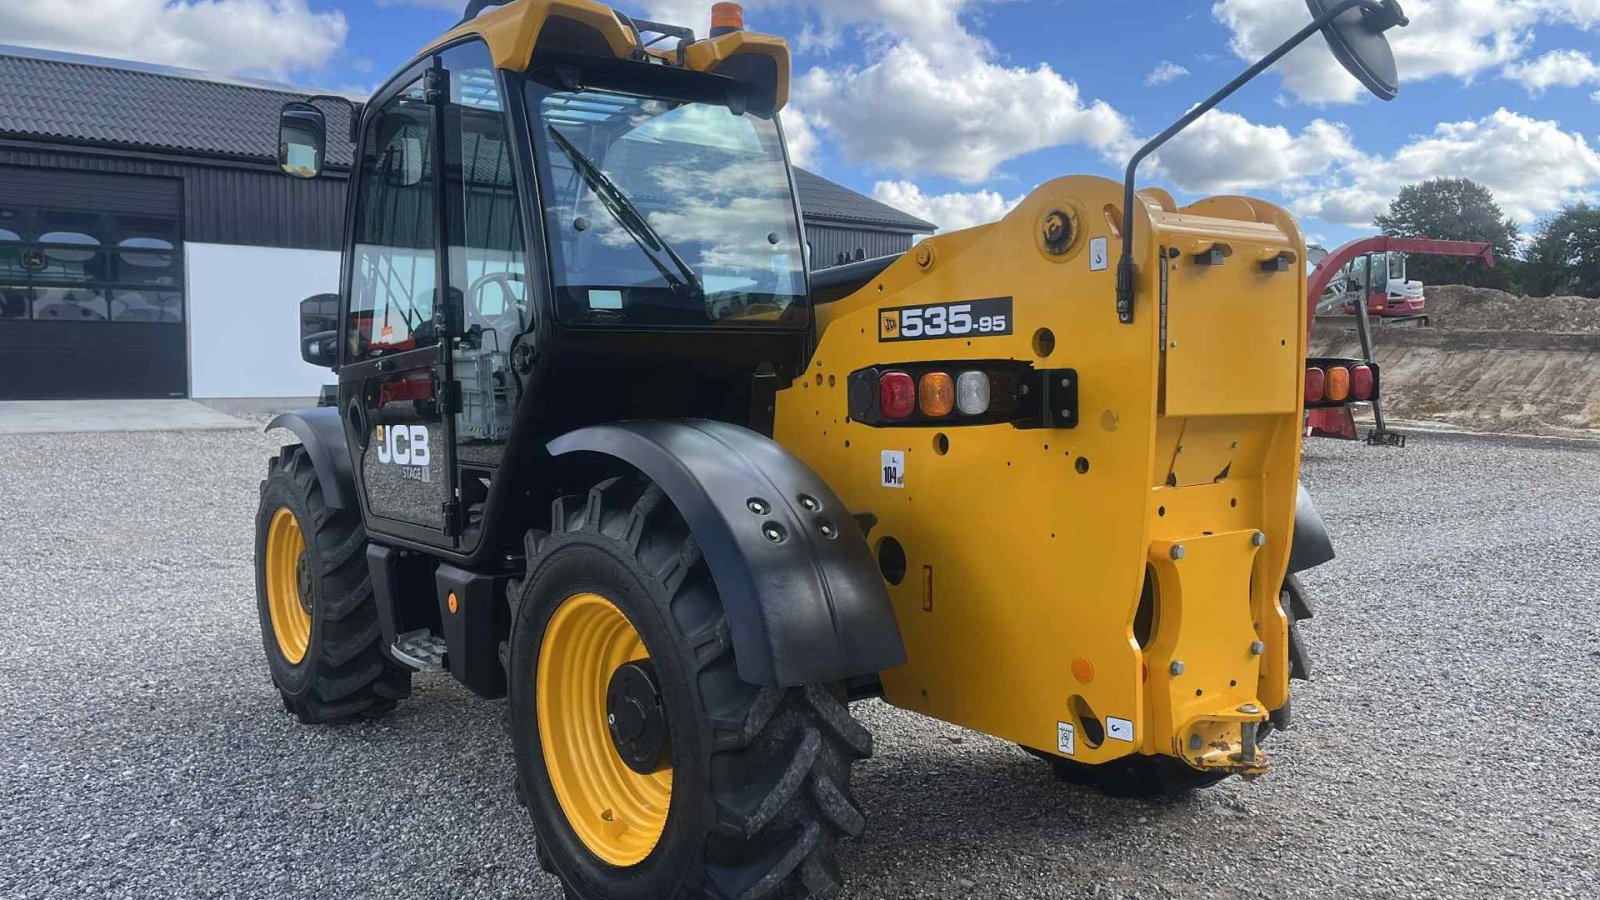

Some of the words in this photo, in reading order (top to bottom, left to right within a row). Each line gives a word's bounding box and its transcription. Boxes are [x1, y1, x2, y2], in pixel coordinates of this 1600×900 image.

[901, 304, 1006, 337] 535-95
[377, 425, 430, 465] JCB
[402, 467, 421, 480] STAGE
[883, 466, 897, 484] 104
